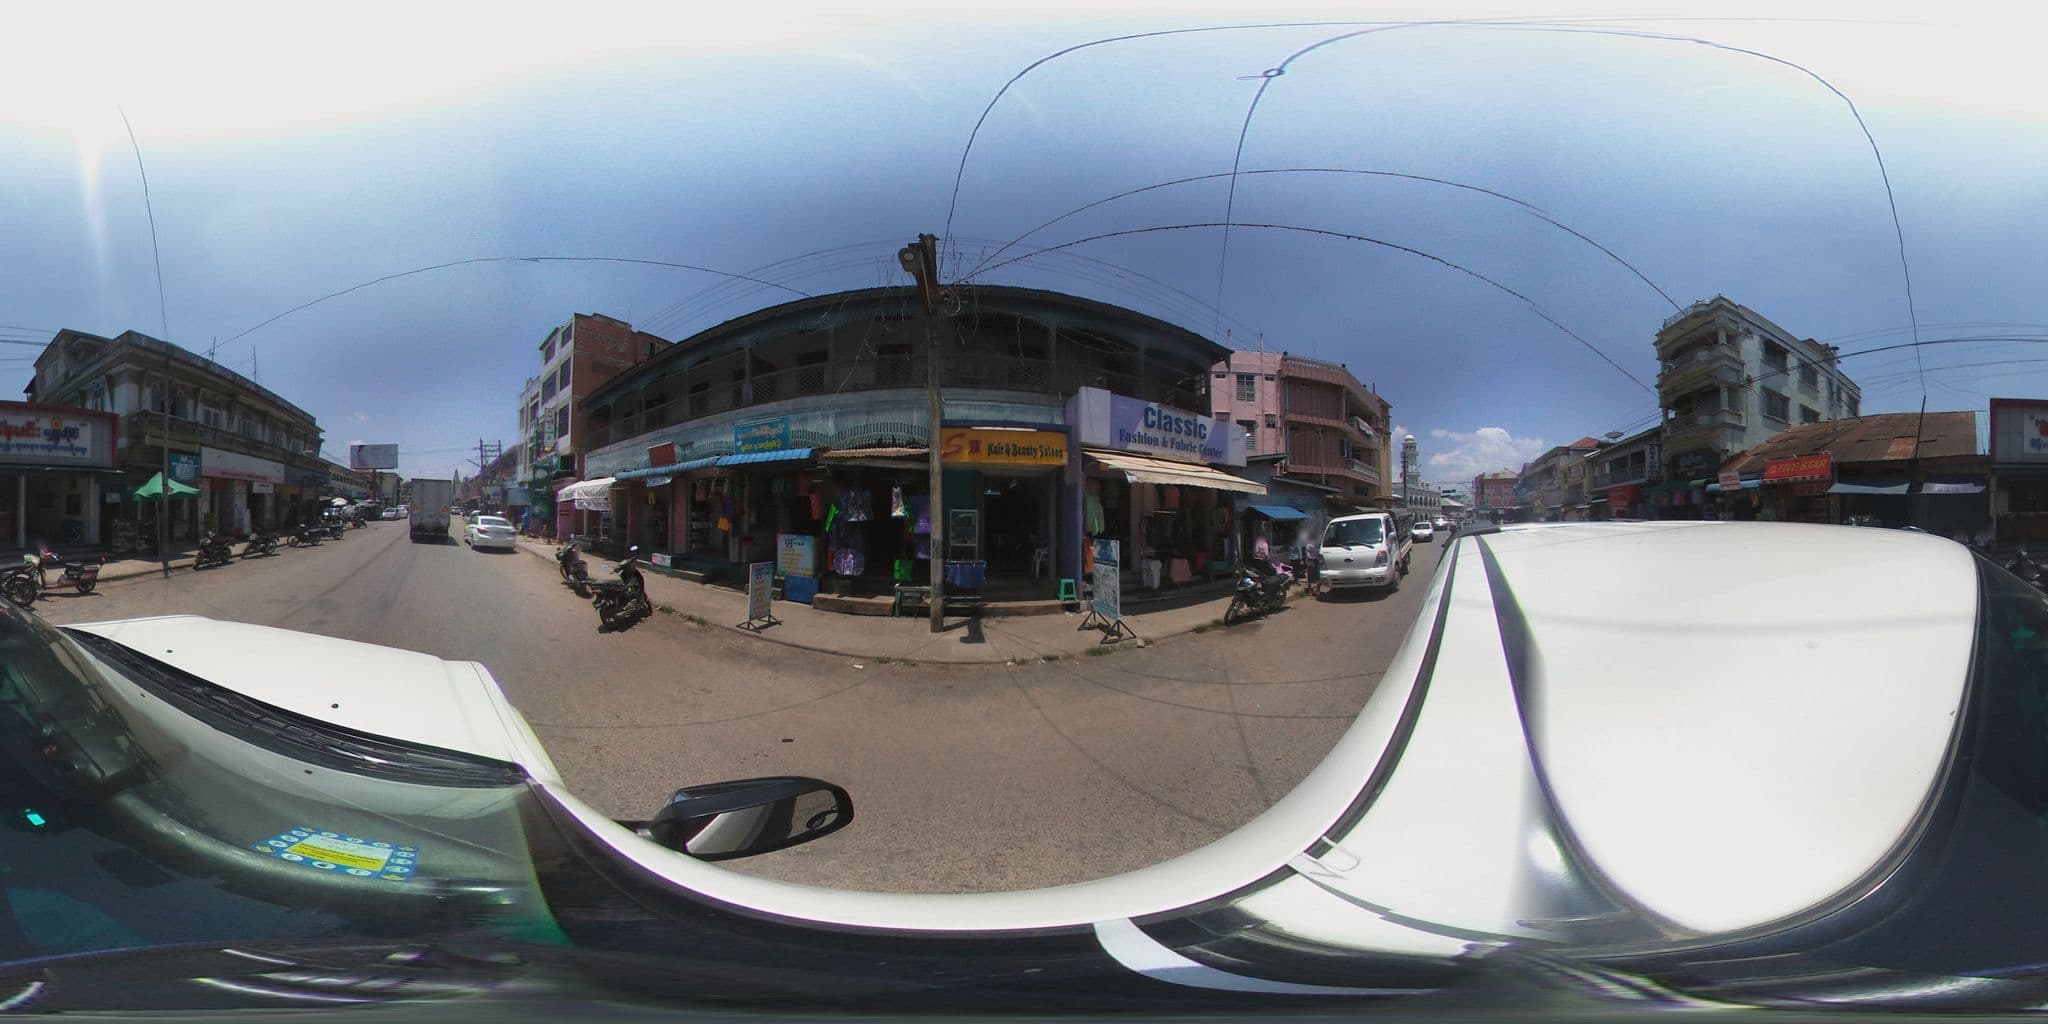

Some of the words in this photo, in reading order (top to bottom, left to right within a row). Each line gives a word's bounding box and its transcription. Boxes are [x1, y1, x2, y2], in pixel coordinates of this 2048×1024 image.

[1143, 406, 1208, 440] Classic
[987, 442, 1004, 457] Hair
[1011, 443, 1038, 459] Beauty
[1119, 428, 1159, 447] Fashion
[1161, 437, 1168, 448] &
[1170, 437, 1197, 452] Fabric
[1199, 443, 1224, 459] Center
[1800, 459, 1827, 470] STAR
